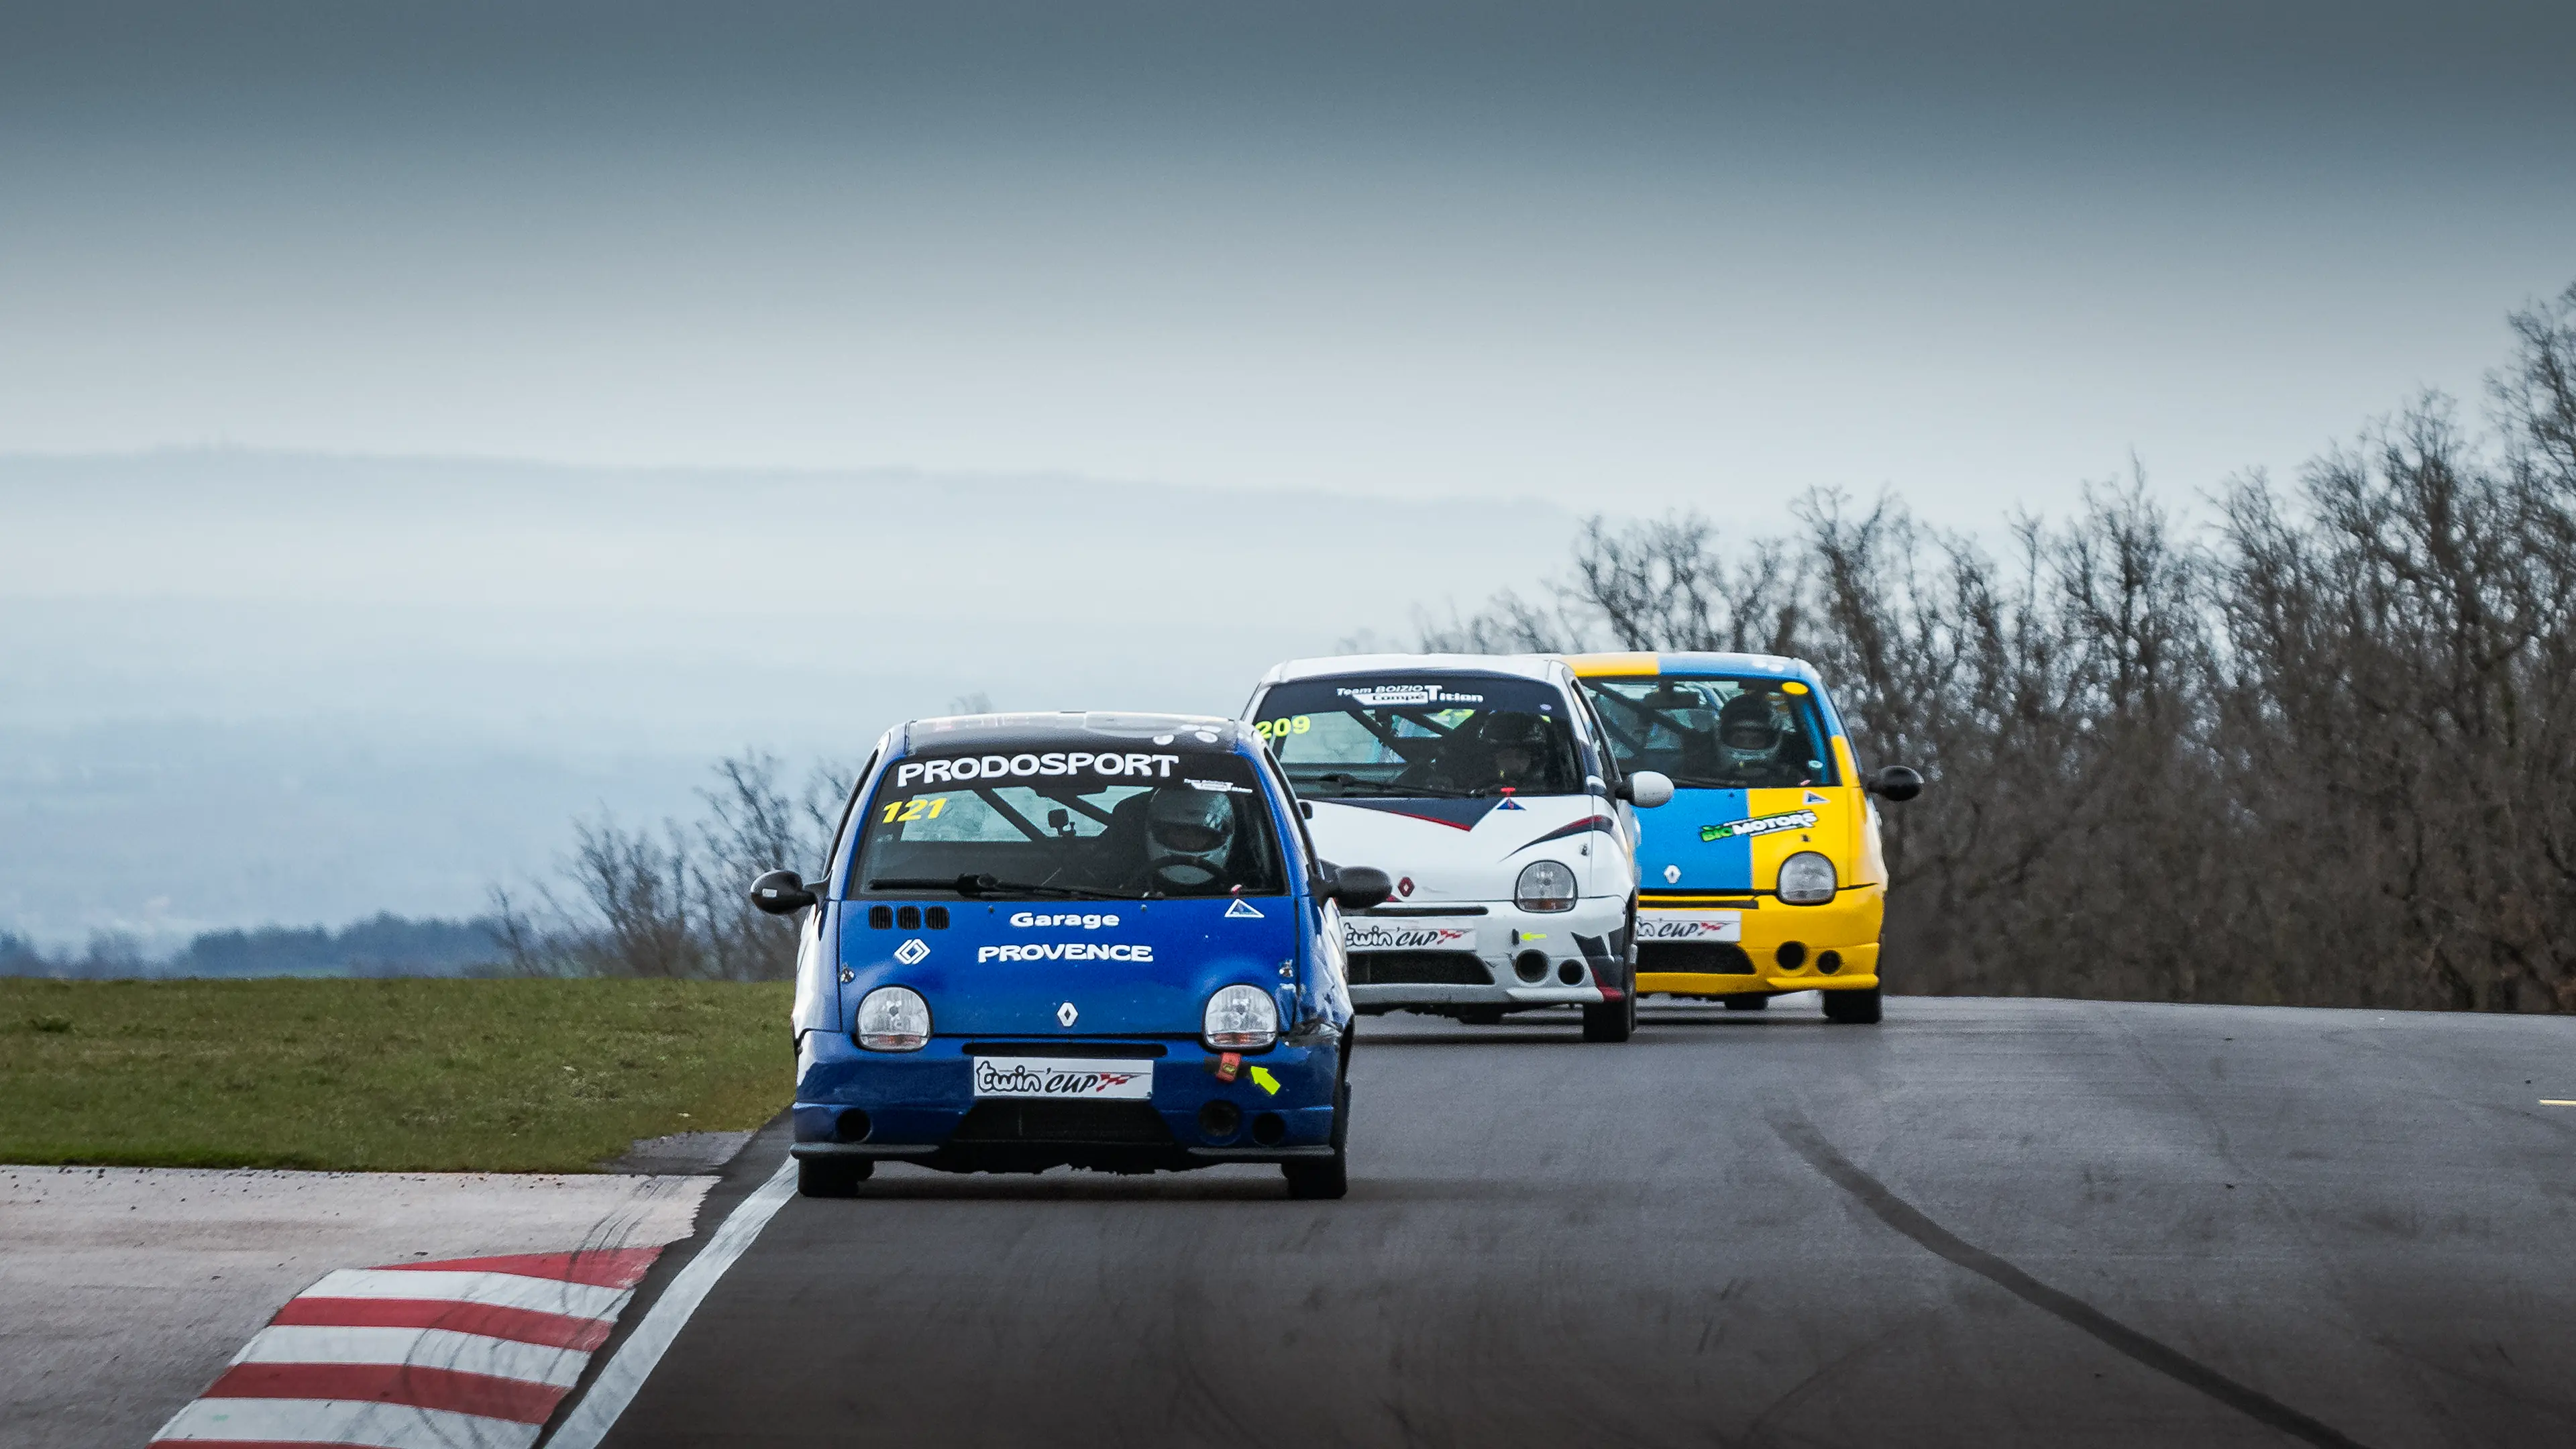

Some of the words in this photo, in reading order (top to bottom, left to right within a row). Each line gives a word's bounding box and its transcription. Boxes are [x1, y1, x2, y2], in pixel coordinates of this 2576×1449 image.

[1255, 715, 1311, 739] 209
[897, 753, 1179, 788] PRODOSPORT
[881, 798, 947, 824] 121
[1009, 912, 1120, 929] Garage
[977, 944, 1154, 963] PROVENCE
